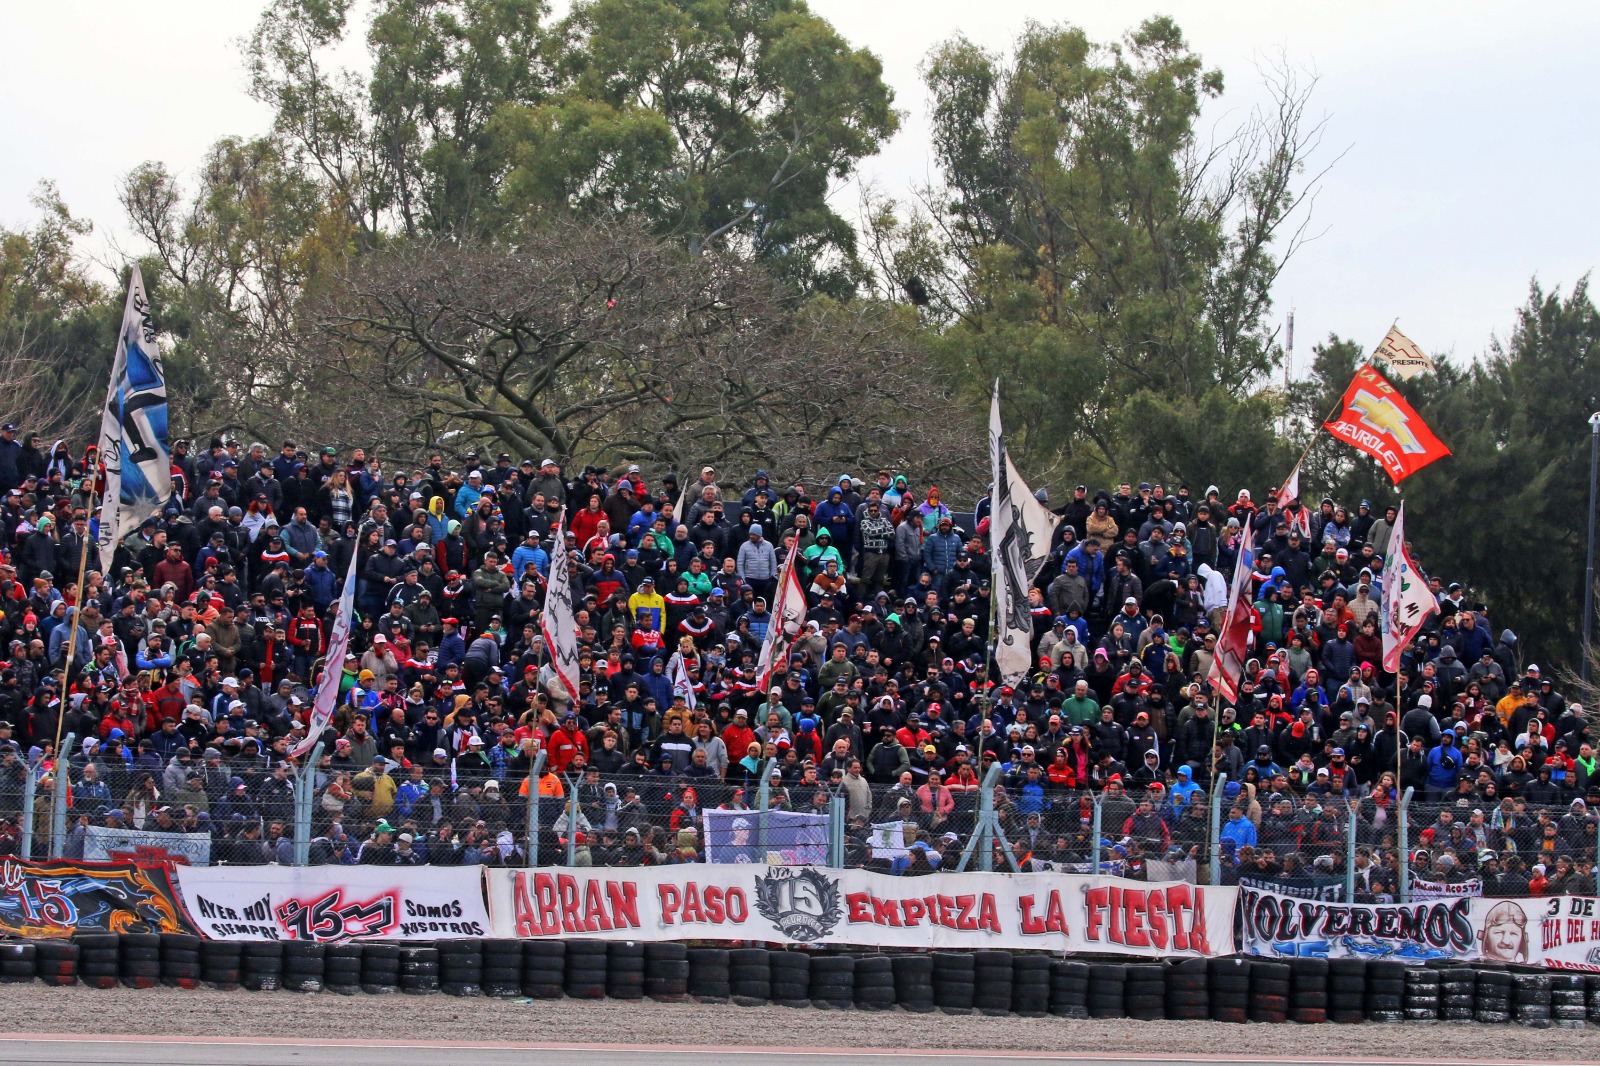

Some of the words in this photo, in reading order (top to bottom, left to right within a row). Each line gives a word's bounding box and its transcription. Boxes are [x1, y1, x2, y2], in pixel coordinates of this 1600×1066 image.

[1375, 382, 1396, 395] 15
[9, 880, 79, 927] 15
[243, 892, 274, 921] HOY
[404, 899, 462, 918] SOMOS
[514, 871, 641, 937] ABRAN
[658, 881, 749, 926] PASO
[778, 880, 823, 915] 15
[1547, 897, 1560, 916] 3
[1569, 897, 1596, 917] DE
[211, 923, 280, 940] SIEMPRE
[287, 890, 344, 941] 15
[400, 921, 484, 936] NOSOTROS
[845, 891, 1003, 934] EMPIEZA
[1018, 889, 1070, 937] LA
[1084, 884, 1212, 956] FIESTA
[1241, 888, 1477, 952] VOLVEREMOS
[1542, 918, 1562, 951] DIA
[1567, 918, 1586, 943] DEL
